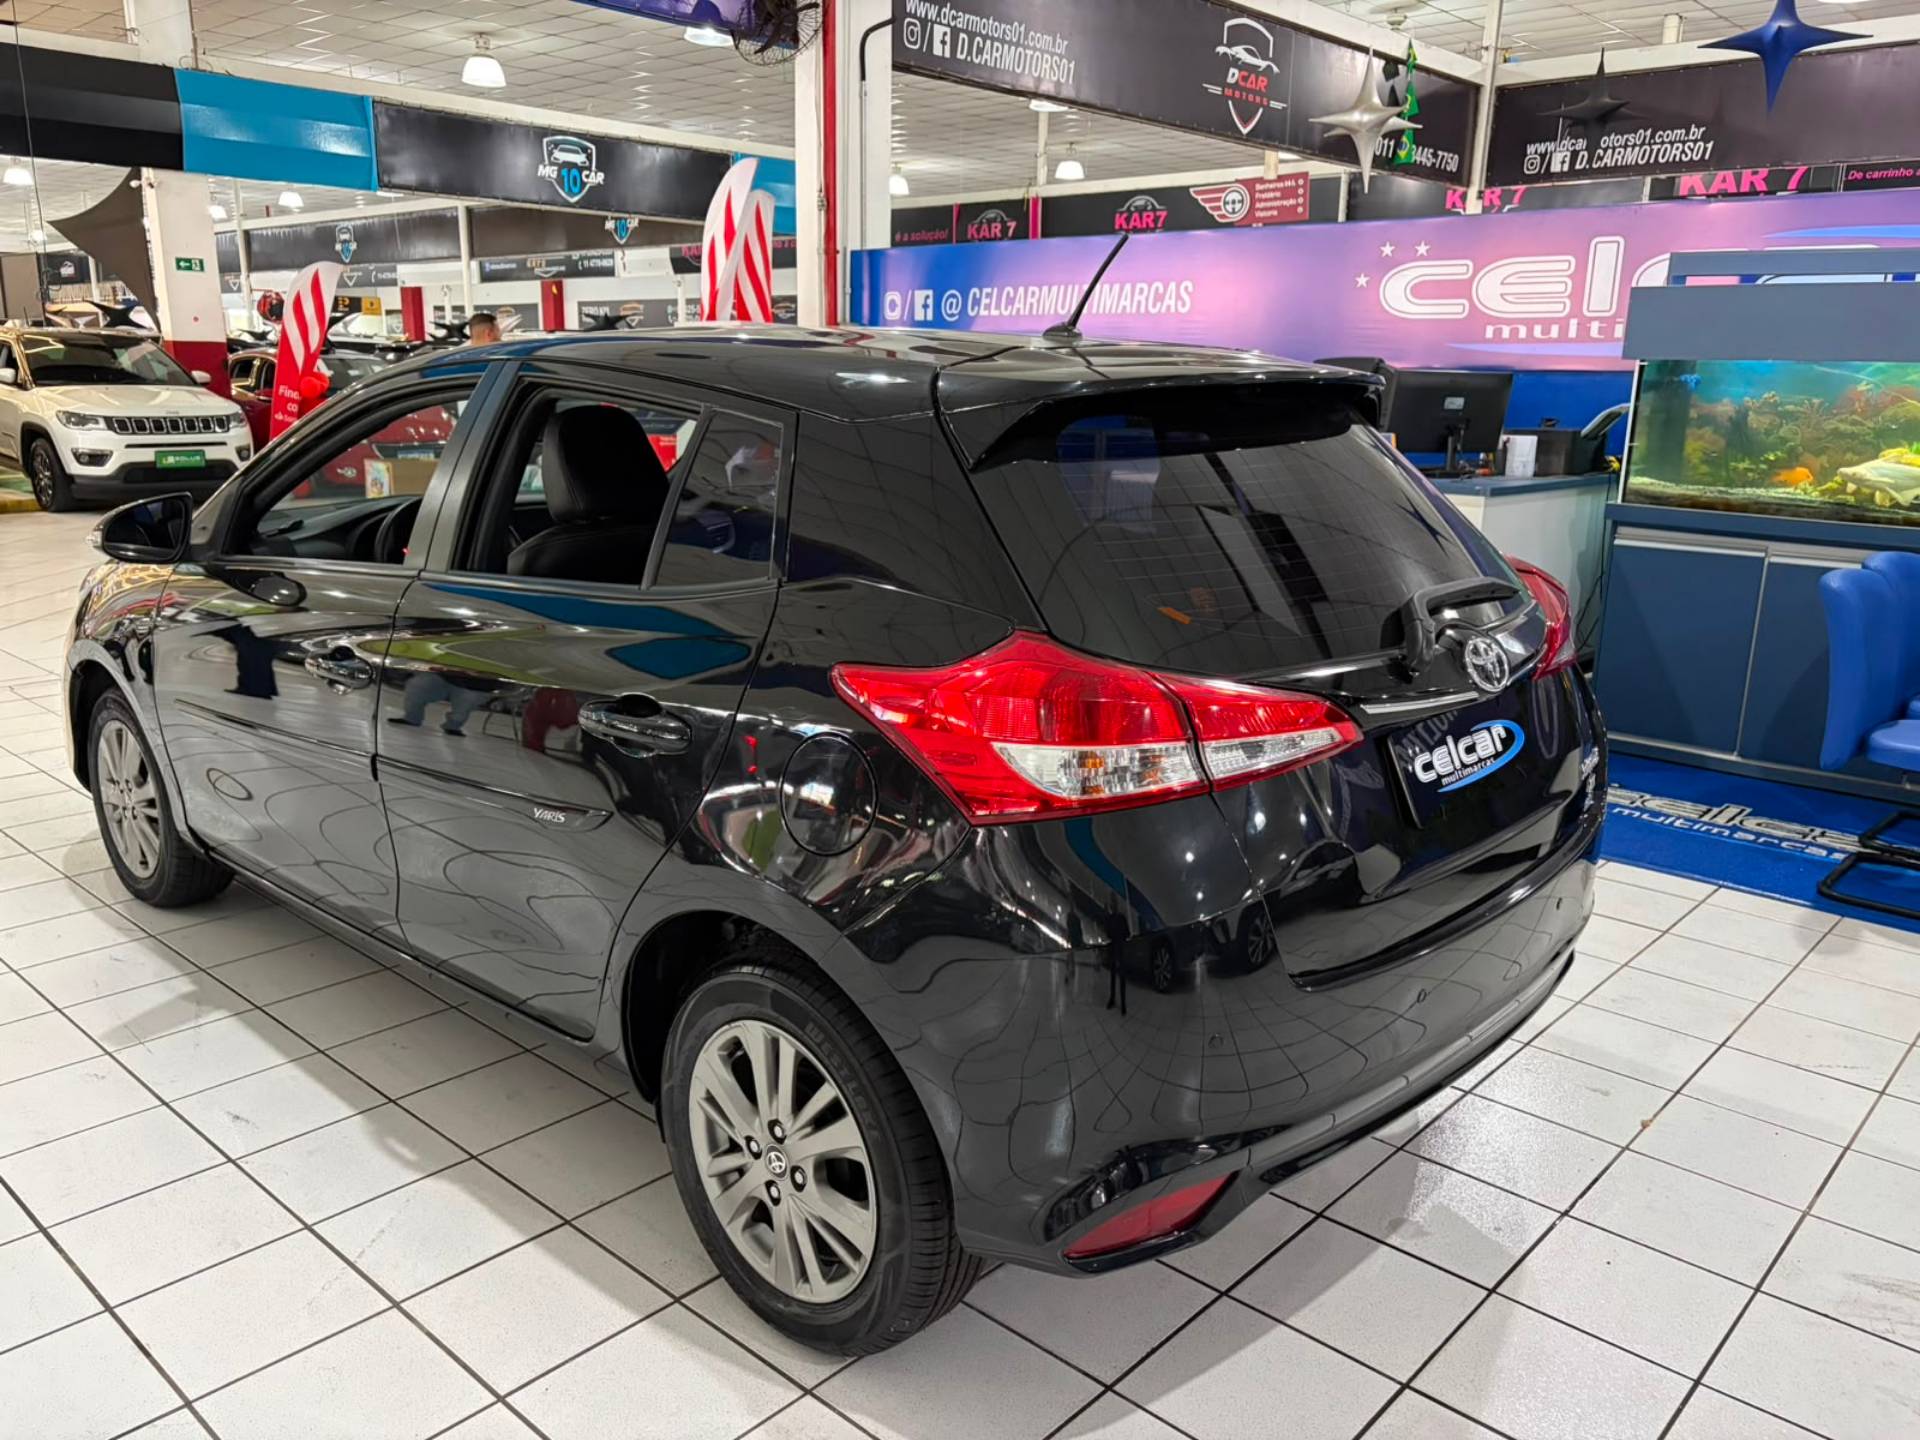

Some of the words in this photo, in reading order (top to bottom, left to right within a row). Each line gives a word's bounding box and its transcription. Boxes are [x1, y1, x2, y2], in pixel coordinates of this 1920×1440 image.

[905, 0, 1069, 54] www.dcarmotors01.com.br
[956, 32, 1076, 85] D.CARMOTORS01
[1226, 67, 1269, 93] DCAR
[1224, 87, 1269, 107] MOTORS
[1526, 124, 1706, 155] www.dcarotors01.com.br
[537, 164, 558, 178] MG
[561, 168, 582, 193] 10
[582, 170, 605, 185] CAR
[1679, 167, 1769, 197] KAR
[1786, 166, 1808, 191] 7
[1848, 170, 1864, 180] De
[1866, 167, 1914, 179] carrinho
[1445, 187, 1503, 210] KR
[967, 222, 1002, 239] KAR
[1006, 220, 1017, 237] 7
[1485, 318, 1625, 339] multi
[279, 384, 302, 400] Fina
[287, 402, 298, 412] co
[1413, 725, 1508, 783] celcar
[1441, 757, 1496, 786] multimarcas
[534, 807, 567, 823] YARIS
